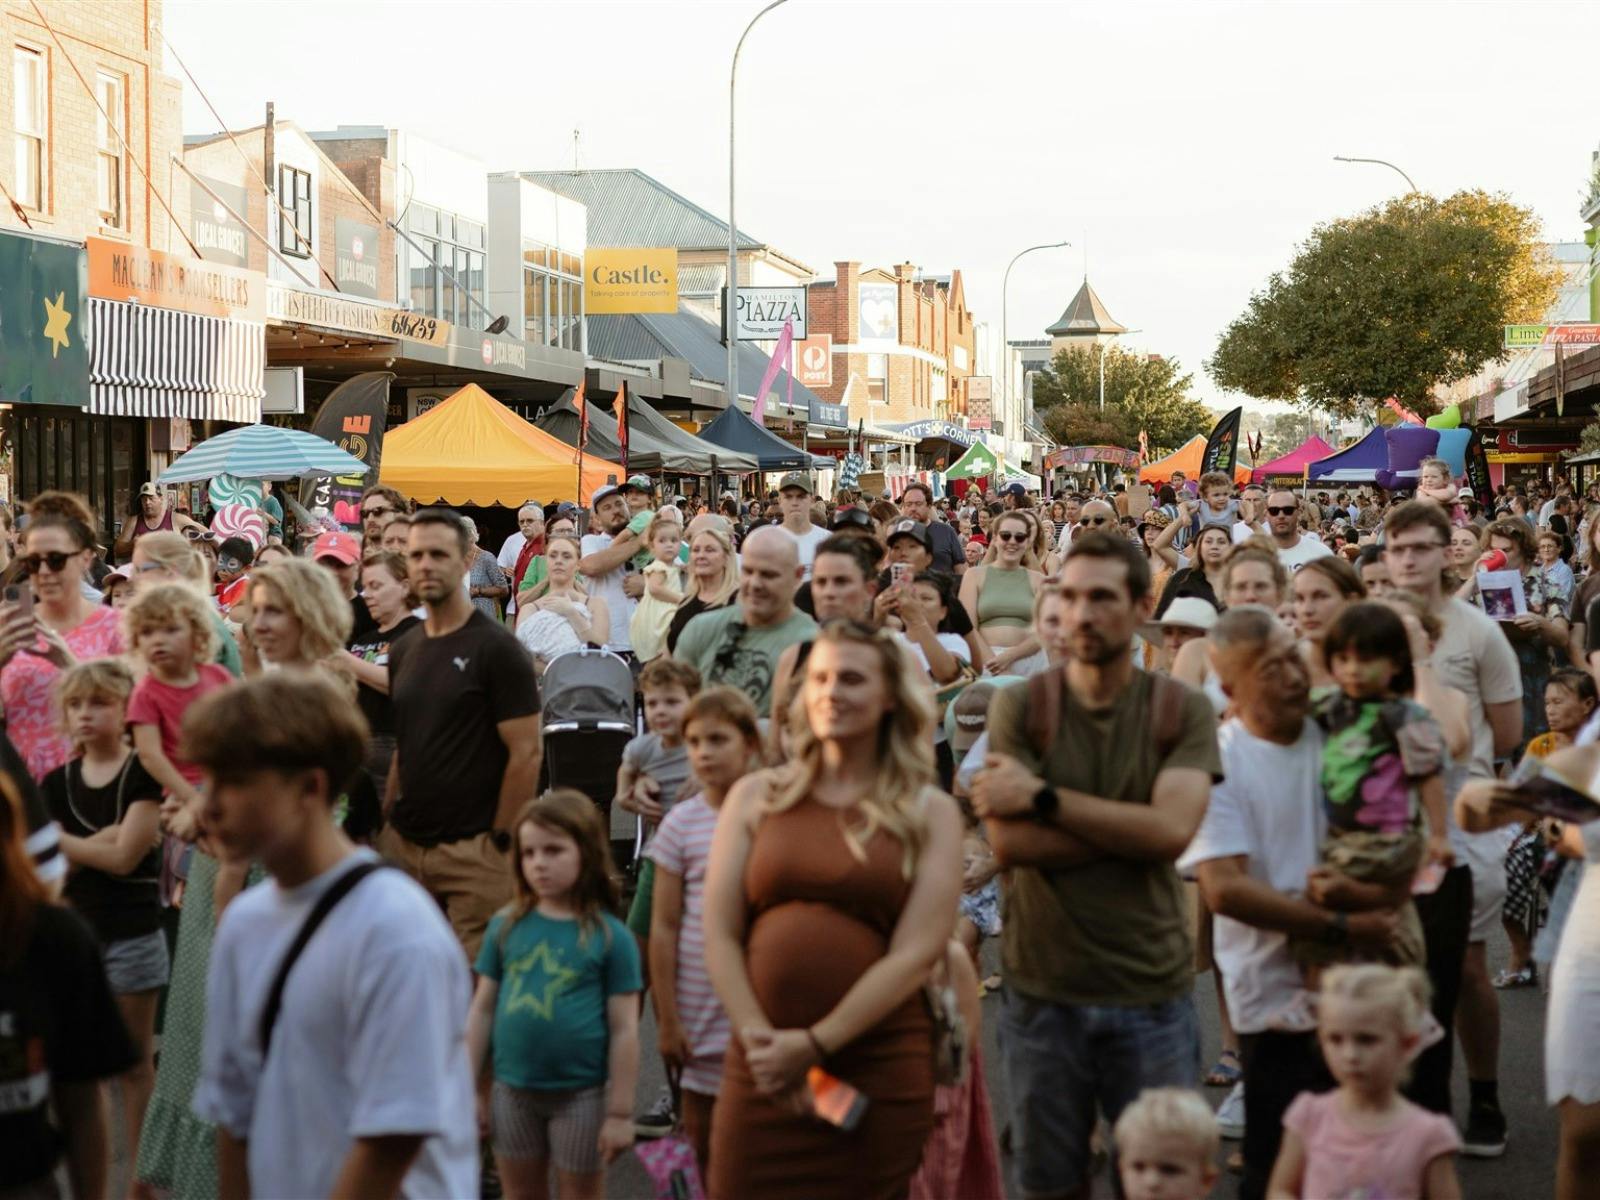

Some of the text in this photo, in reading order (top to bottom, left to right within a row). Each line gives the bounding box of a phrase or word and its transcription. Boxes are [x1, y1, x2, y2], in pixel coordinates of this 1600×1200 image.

[592, 264, 669, 285] Castle.
[179, 266, 249, 307] BOOKSELLERS
[736, 295, 802, 321] PIAZZA
[1510, 327, 1543, 339] Lime
[803, 371, 828, 380] POST
